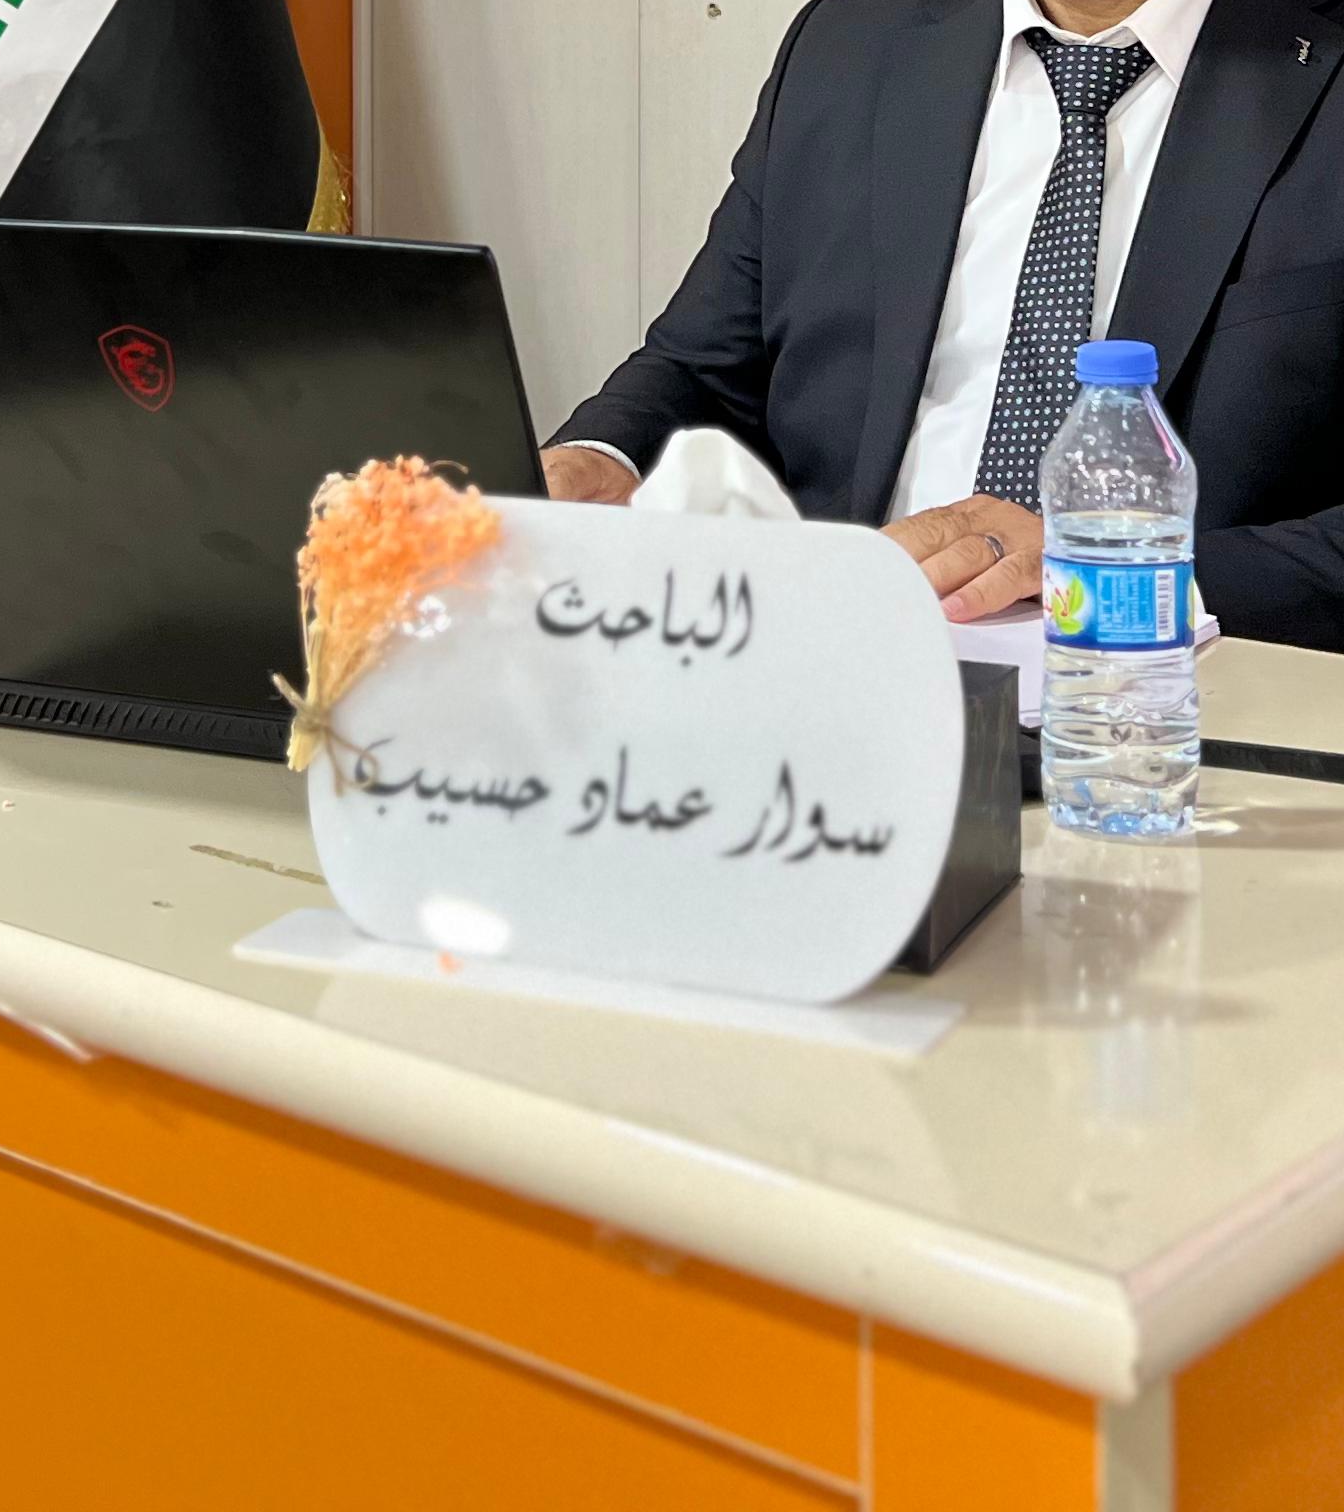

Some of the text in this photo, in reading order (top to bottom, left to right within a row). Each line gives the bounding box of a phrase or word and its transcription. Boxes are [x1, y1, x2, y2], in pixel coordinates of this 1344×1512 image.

[535, 569, 754, 667] الباحث
[354, 735, 897, 862] سوار عماد حسيب
